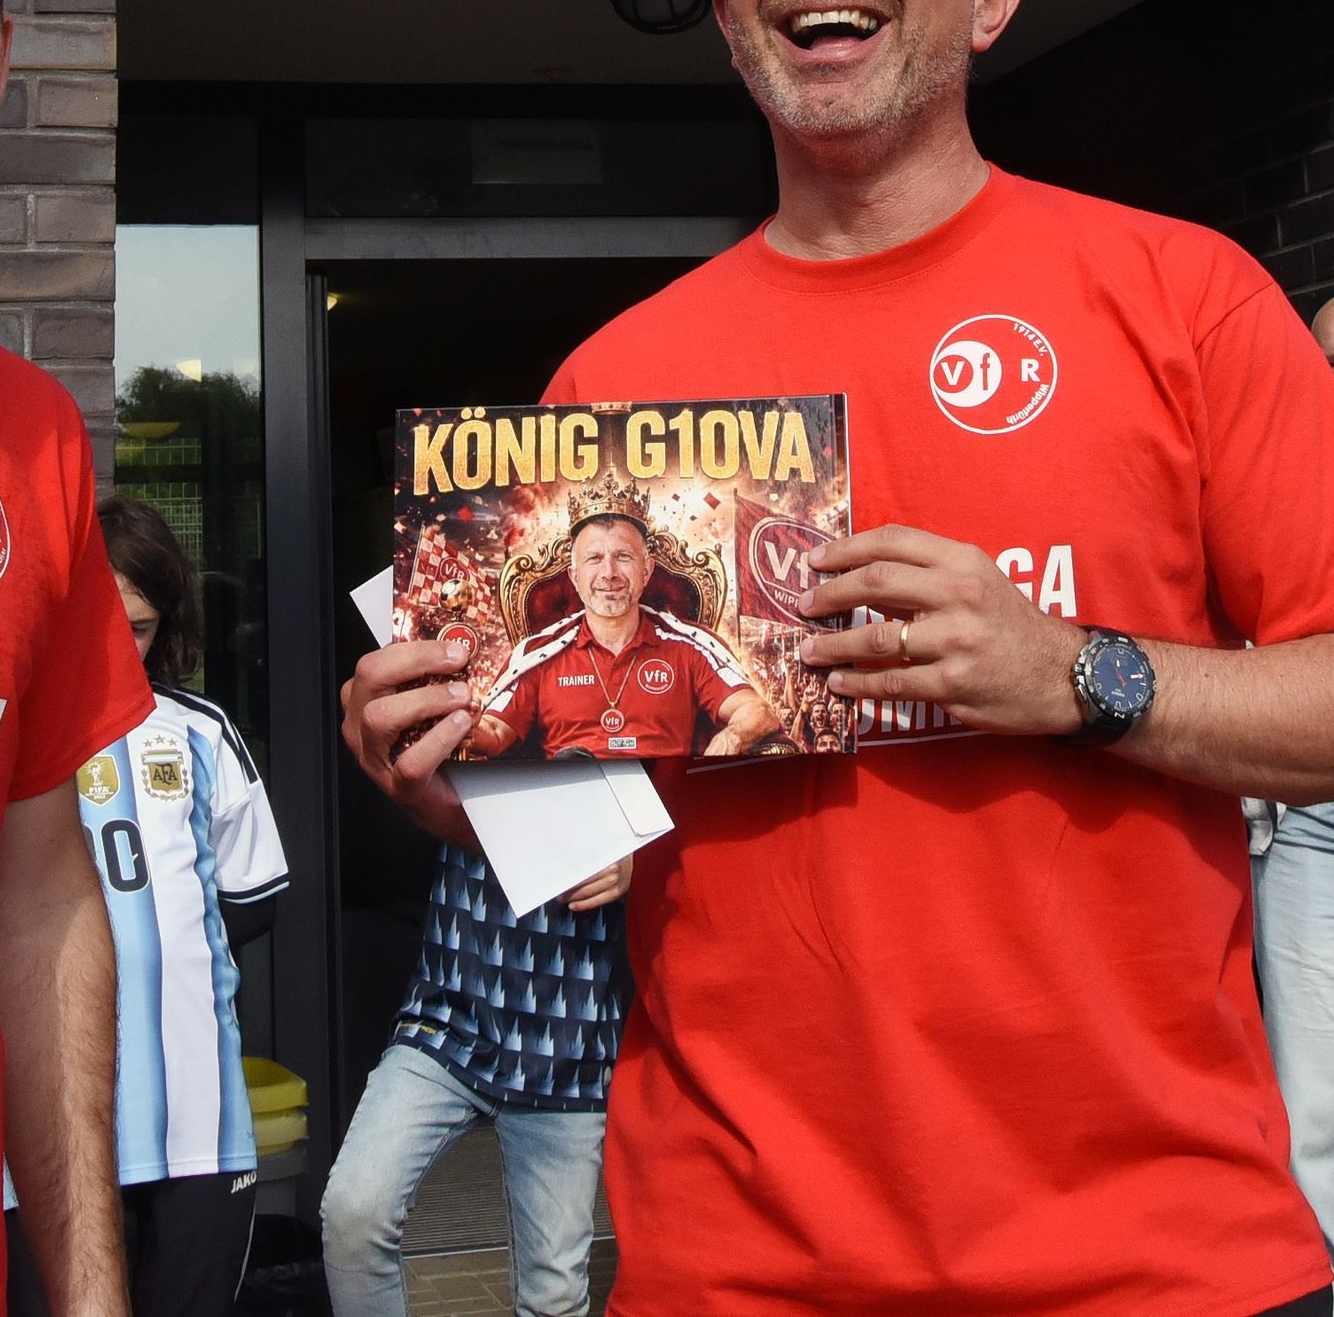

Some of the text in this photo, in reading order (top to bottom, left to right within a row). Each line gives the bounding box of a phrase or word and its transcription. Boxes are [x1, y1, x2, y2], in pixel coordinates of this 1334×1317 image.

[413, 406, 600, 496] KÖNIG
[557, 674, 595, 688] TRAINER
[644, 669, 668, 684] VfR
[230, 1170, 257, 1195] JAKO
